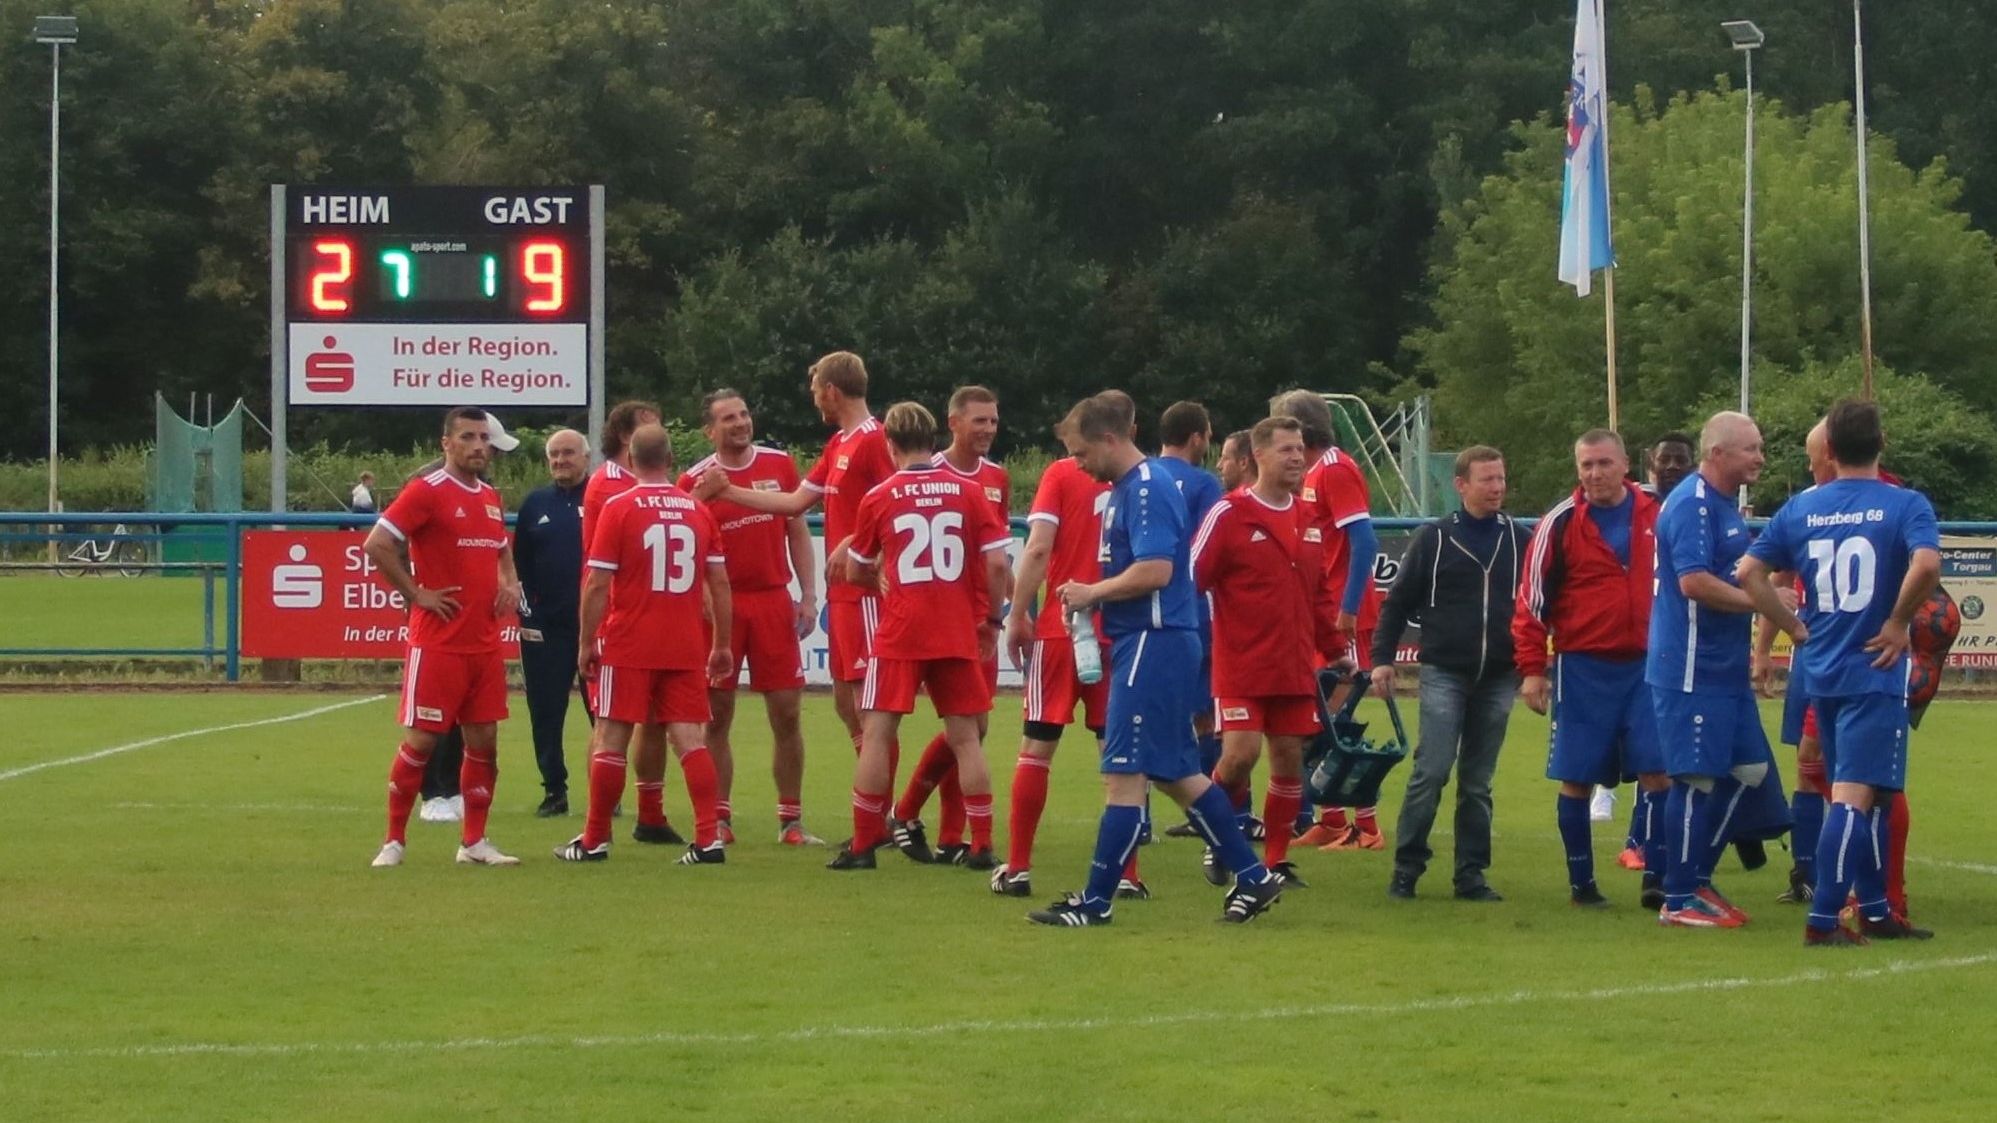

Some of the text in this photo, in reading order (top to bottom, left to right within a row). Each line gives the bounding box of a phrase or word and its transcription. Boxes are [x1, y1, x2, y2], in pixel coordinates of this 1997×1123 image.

[303, 196, 390, 224] HEIM
[484, 197, 573, 224] GAST
[312, 243, 351, 311] 2
[383, 252, 410, 298] 7
[485, 256, 496, 297] 1
[524, 243, 563, 311] 9
[393, 336, 558, 361] In der Region.
[393, 368, 571, 393] Für die Region.
[904, 485, 919, 496] FC
[922, 483, 960, 496] UNION
[649, 496, 663, 508] FC
[663, 496, 696, 511] UNION
[915, 498, 942, 507] BERLIN
[659, 511, 683, 520] BERLIN
[1807, 509, 1884, 528] Herzberg 68
[643, 524, 696, 593] 13
[893, 511, 965, 584] 26
[1940, 550, 1992, 560] o-Center
[1808, 536, 1876, 613] 10
[1952, 562, 1992, 573] Torgau
[344, 583, 407, 609] Elbe
[344, 626, 360, 641] In
[365, 625, 394, 642] der
